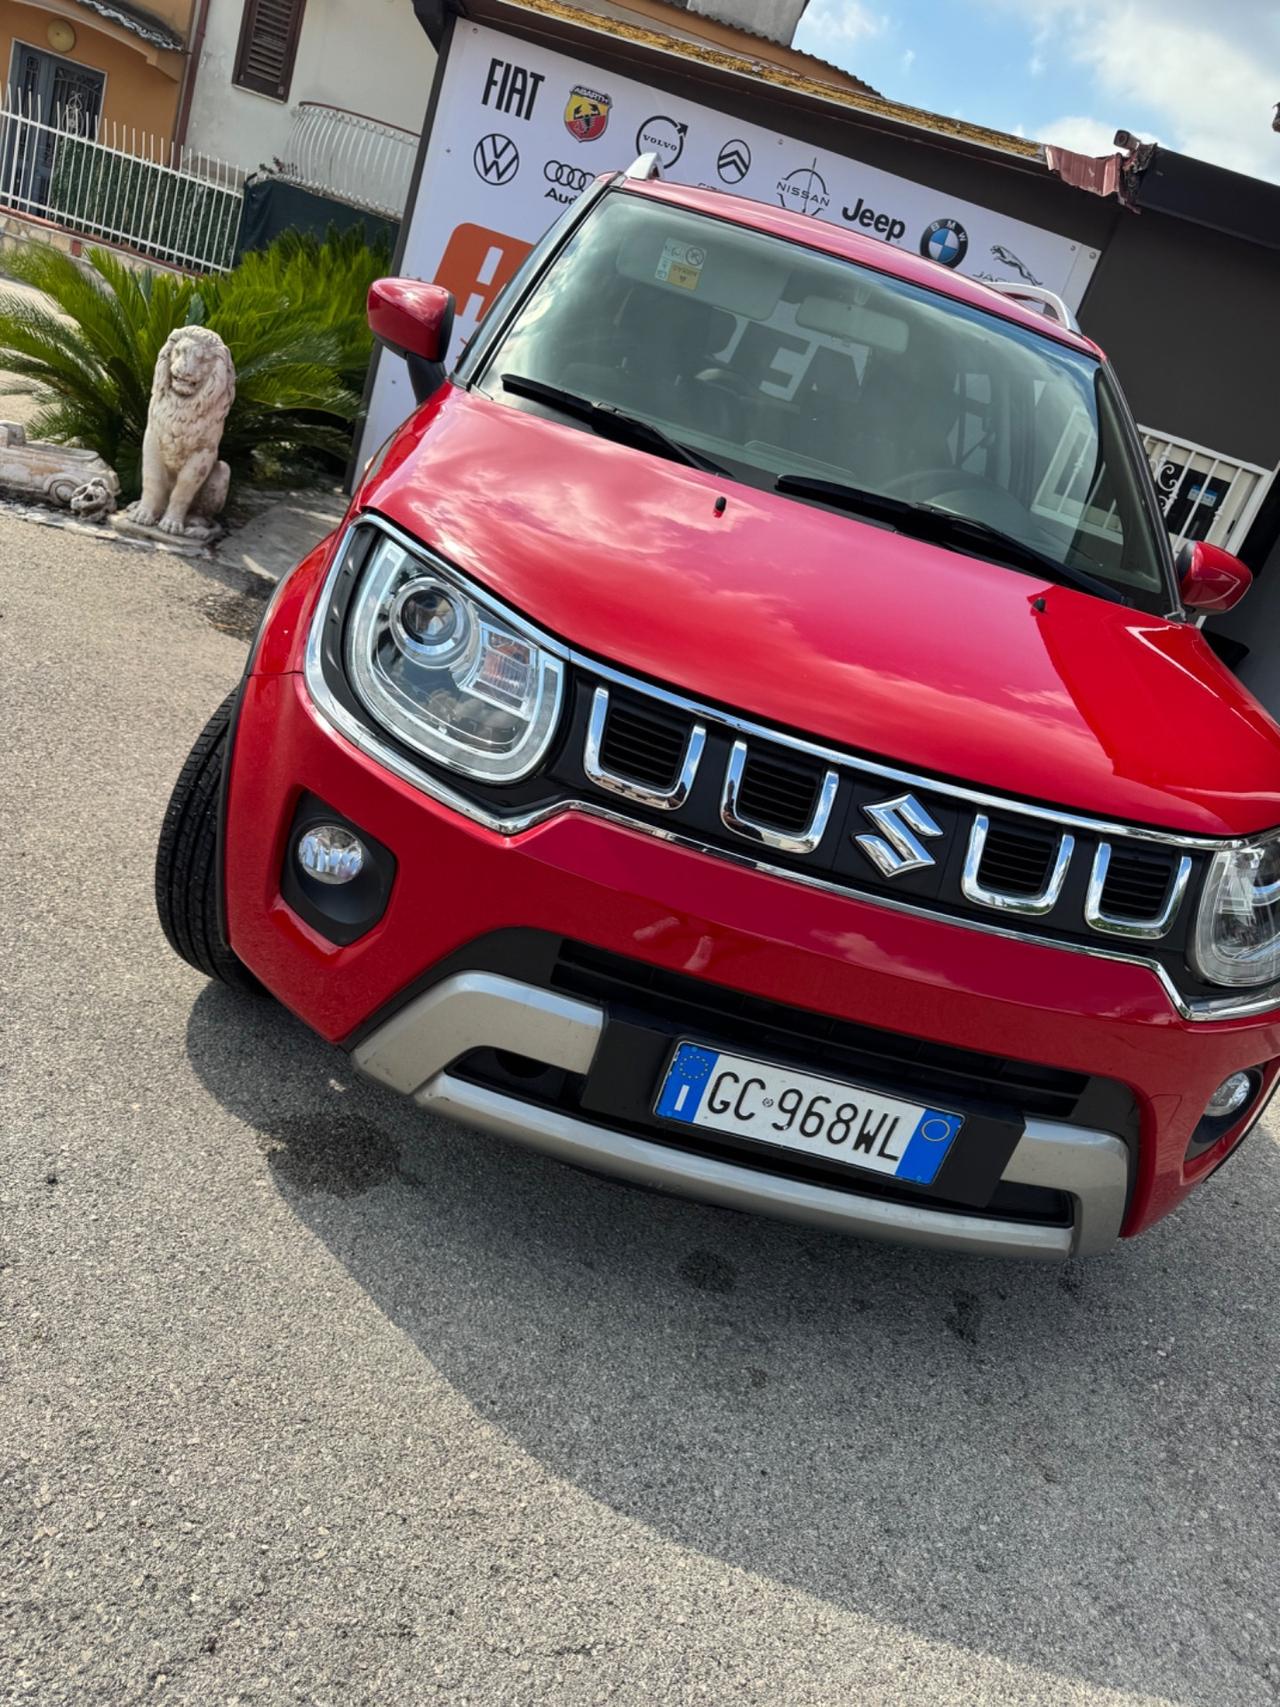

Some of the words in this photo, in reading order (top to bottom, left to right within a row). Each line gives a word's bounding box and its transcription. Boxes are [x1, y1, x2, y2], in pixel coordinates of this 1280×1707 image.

[481, 57, 546, 121] FIAT
[642, 134, 678, 152] VOLVO
[776, 181, 830, 207] NISSAN
[842, 198, 906, 241] Jeep
